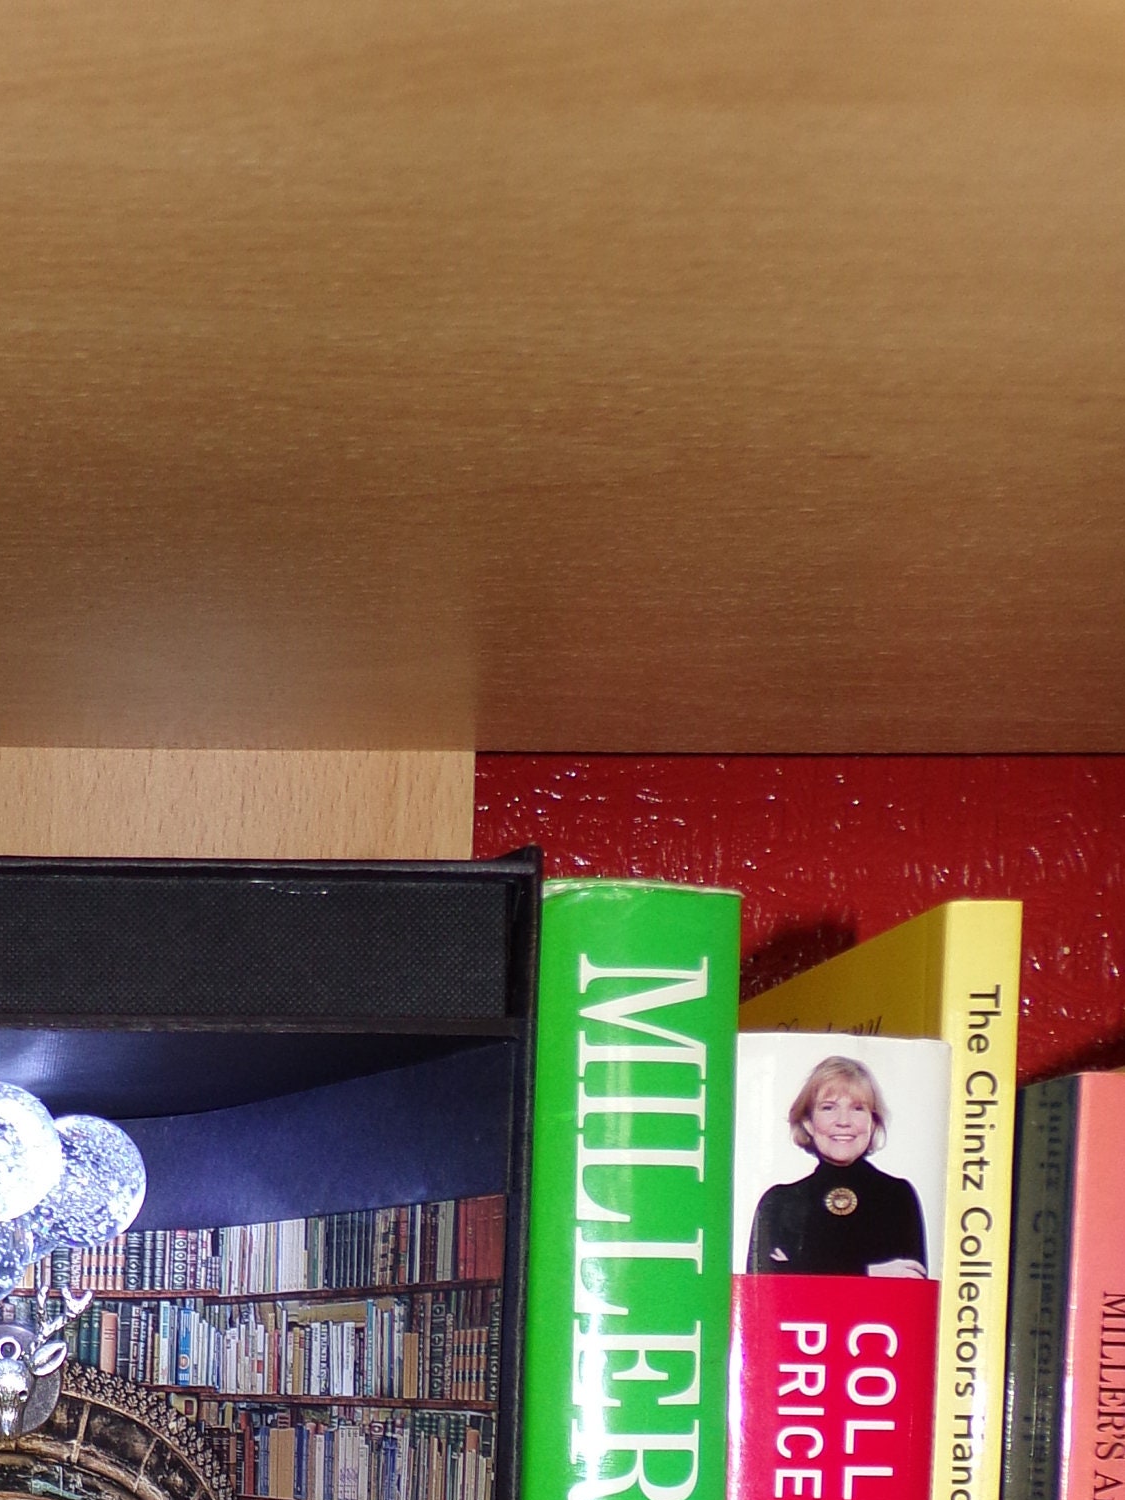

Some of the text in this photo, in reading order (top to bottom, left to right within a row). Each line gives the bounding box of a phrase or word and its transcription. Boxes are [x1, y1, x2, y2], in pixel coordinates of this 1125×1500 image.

[966, 983, 1002, 1055] The
[962, 1070, 997, 1190] Chintz
[954, 1207, 991, 1398] Collectors
[1094, 1291, 1125, 1461] MILLER'S
[774, 1321, 828, 1500] PRICE
